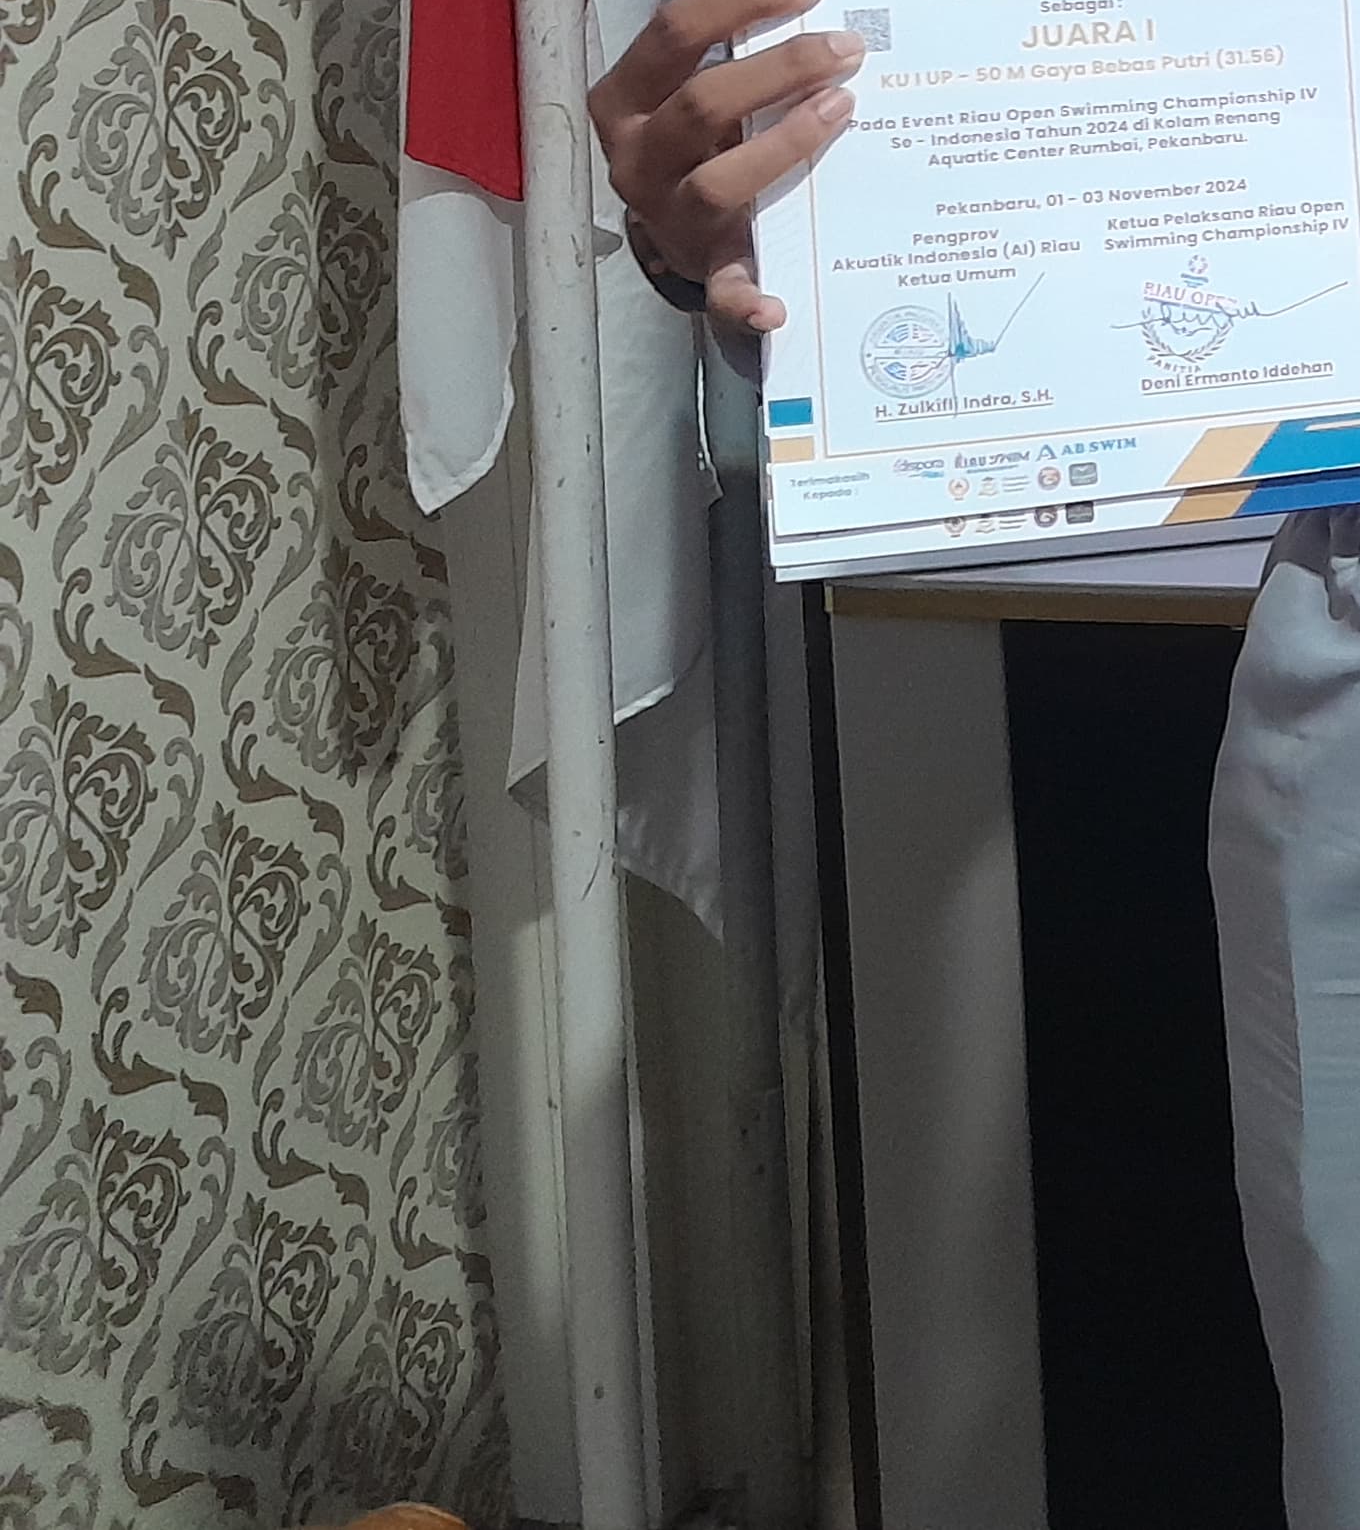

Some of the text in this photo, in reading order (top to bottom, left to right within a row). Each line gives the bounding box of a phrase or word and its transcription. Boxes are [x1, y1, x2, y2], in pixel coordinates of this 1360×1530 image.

[1022, 20, 1137, 48] JUARA
[881, 73, 910, 89] KU
[927, 69, 952, 85] UP
[976, 66, 1002, 82] 50
[1007, 65, 1025, 80] M
[1031, 63, 1087, 82] Gaya
[1092, 57, 1156, 75] Bebas
[1162, 51, 1210, 69] Putri
[1216, 44, 1285, 69] (31.56)
[849, 87, 1318, 132] Pada Event Riau Open Swimming Championship IV
[931, 129, 1021, 147] Indonesia
[1026, 125, 1082, 140] Tahun
[1086, 120, 1129, 136] 2024
[1133, 117, 1150, 132] di
[1153, 114, 1211, 131] Kolam
[1215, 110, 1281, 126] Renang
[928, 131, 1249, 169] Aquatic Center Rumbai, Pekanbaru.
[936, 196, 1041, 216] Pekanbaru,
[1046, 193, 1064, 207] 01
[1083, 189, 1103, 204] 03
[1109, 183, 1201, 202] November
[1205, 178, 1247, 195] 2024
[1107, 200, 1345, 231] Ketua Pelaksana Riau Open
[913, 228, 1000, 247] Pengprov
[1104, 217, 1349, 251] Swimming Championship IV
[832, 239, 1081, 272] Akuatik Indonesia (AI) Riau
[898, 267, 1017, 287] Ketua Umum
[1141, 372, 1180, 392] Deni
[1185, 368, 1259, 388] Ermanto
[875, 404, 893, 418] H.
[963, 393, 1016, 410] Indra,
[1021, 388, 1055, 404] S.H.
[1088, 437, 1137, 453] SWIM
